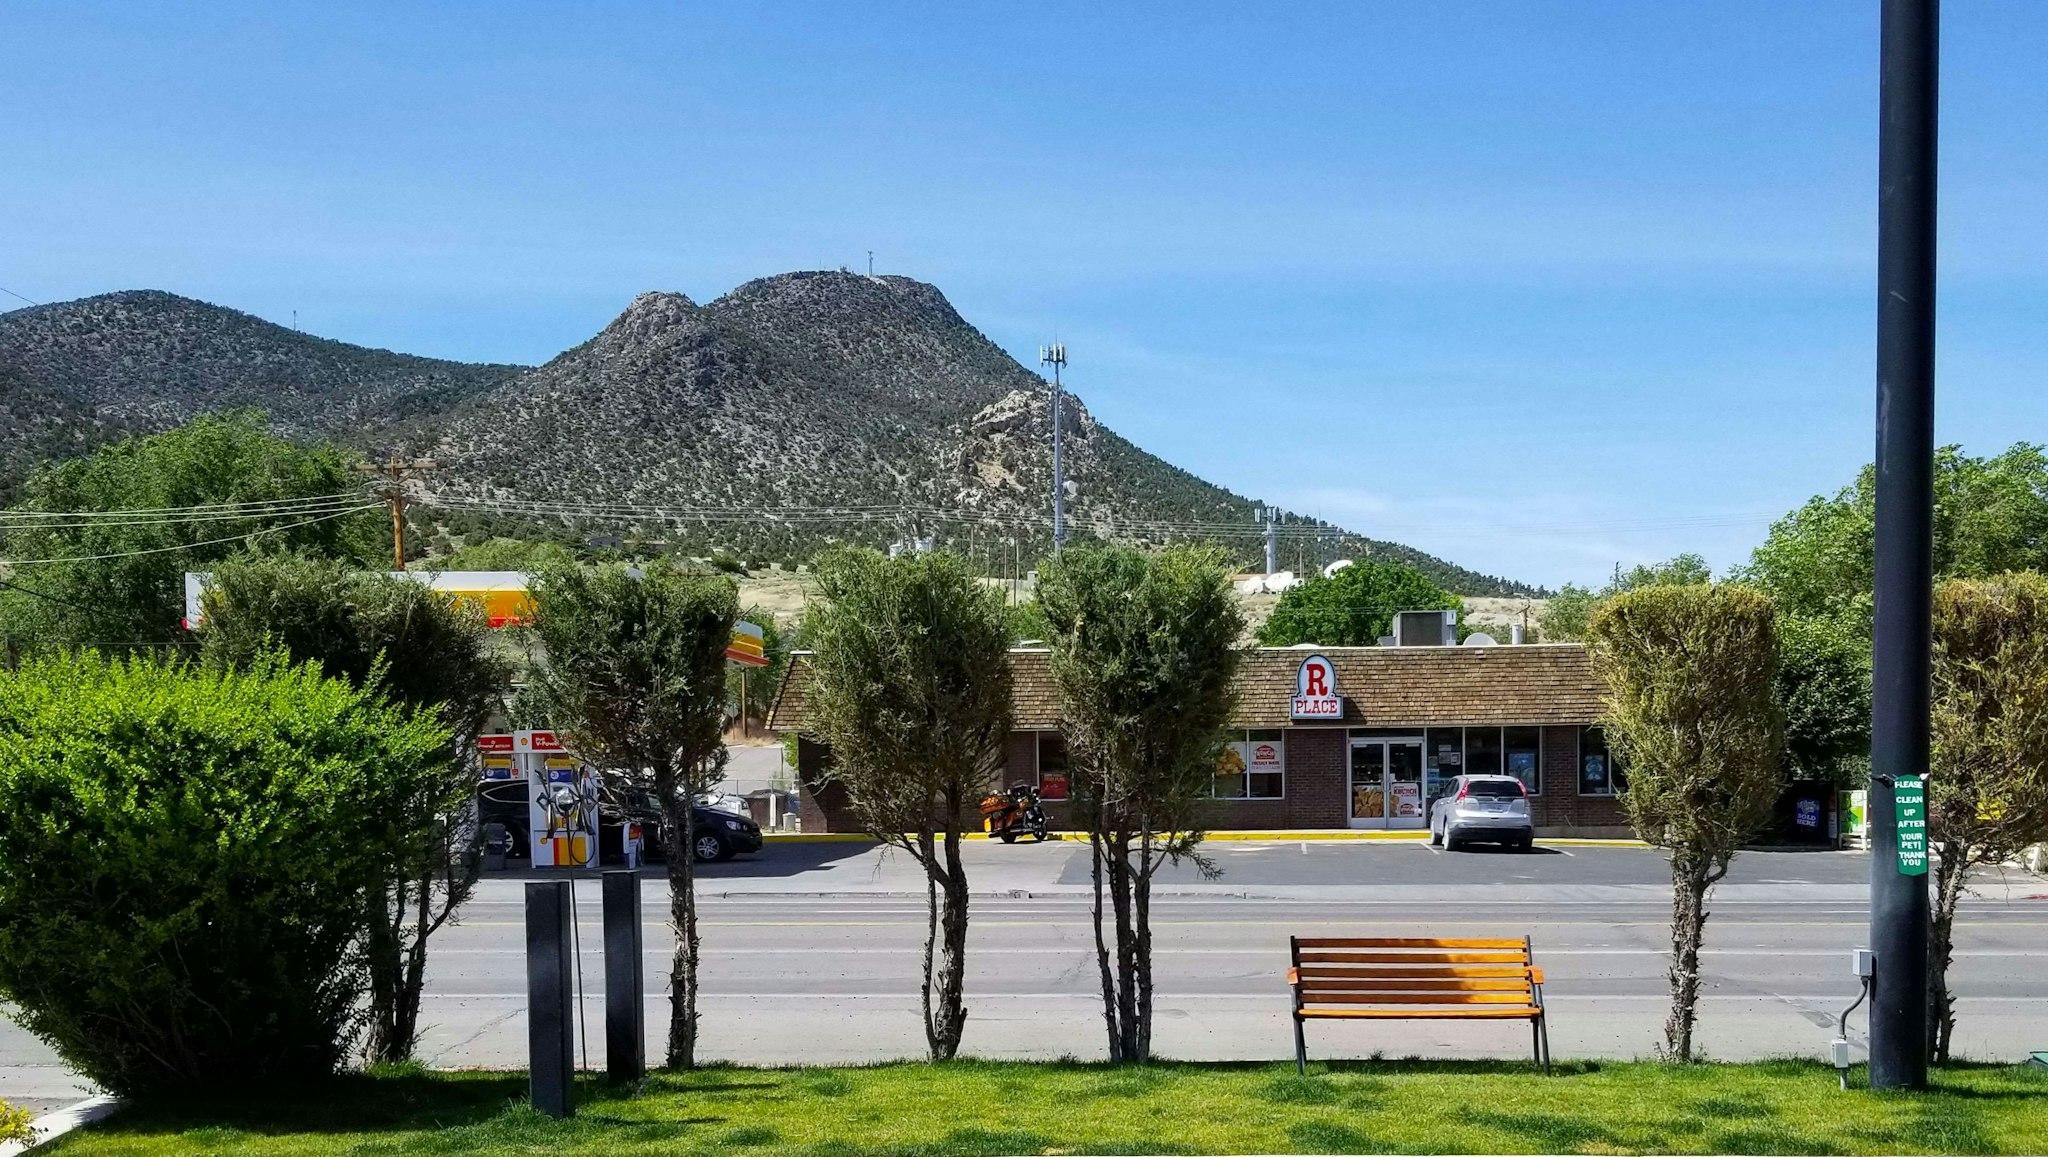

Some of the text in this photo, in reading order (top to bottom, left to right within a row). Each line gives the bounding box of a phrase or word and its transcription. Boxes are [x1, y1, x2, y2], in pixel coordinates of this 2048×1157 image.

[1306, 664, 1328, 696] R
[1295, 700, 1337, 714] PLACE
[1894, 781, 1923, 789] PLEASE
[1896, 796, 1923, 804] CLEAN
[1904, 808, 1916, 817] UP
[1898, 820, 1925, 828] AFTER
[1900, 833, 1923, 841] YOUR
[1899, 851, 1926, 859] THANK
